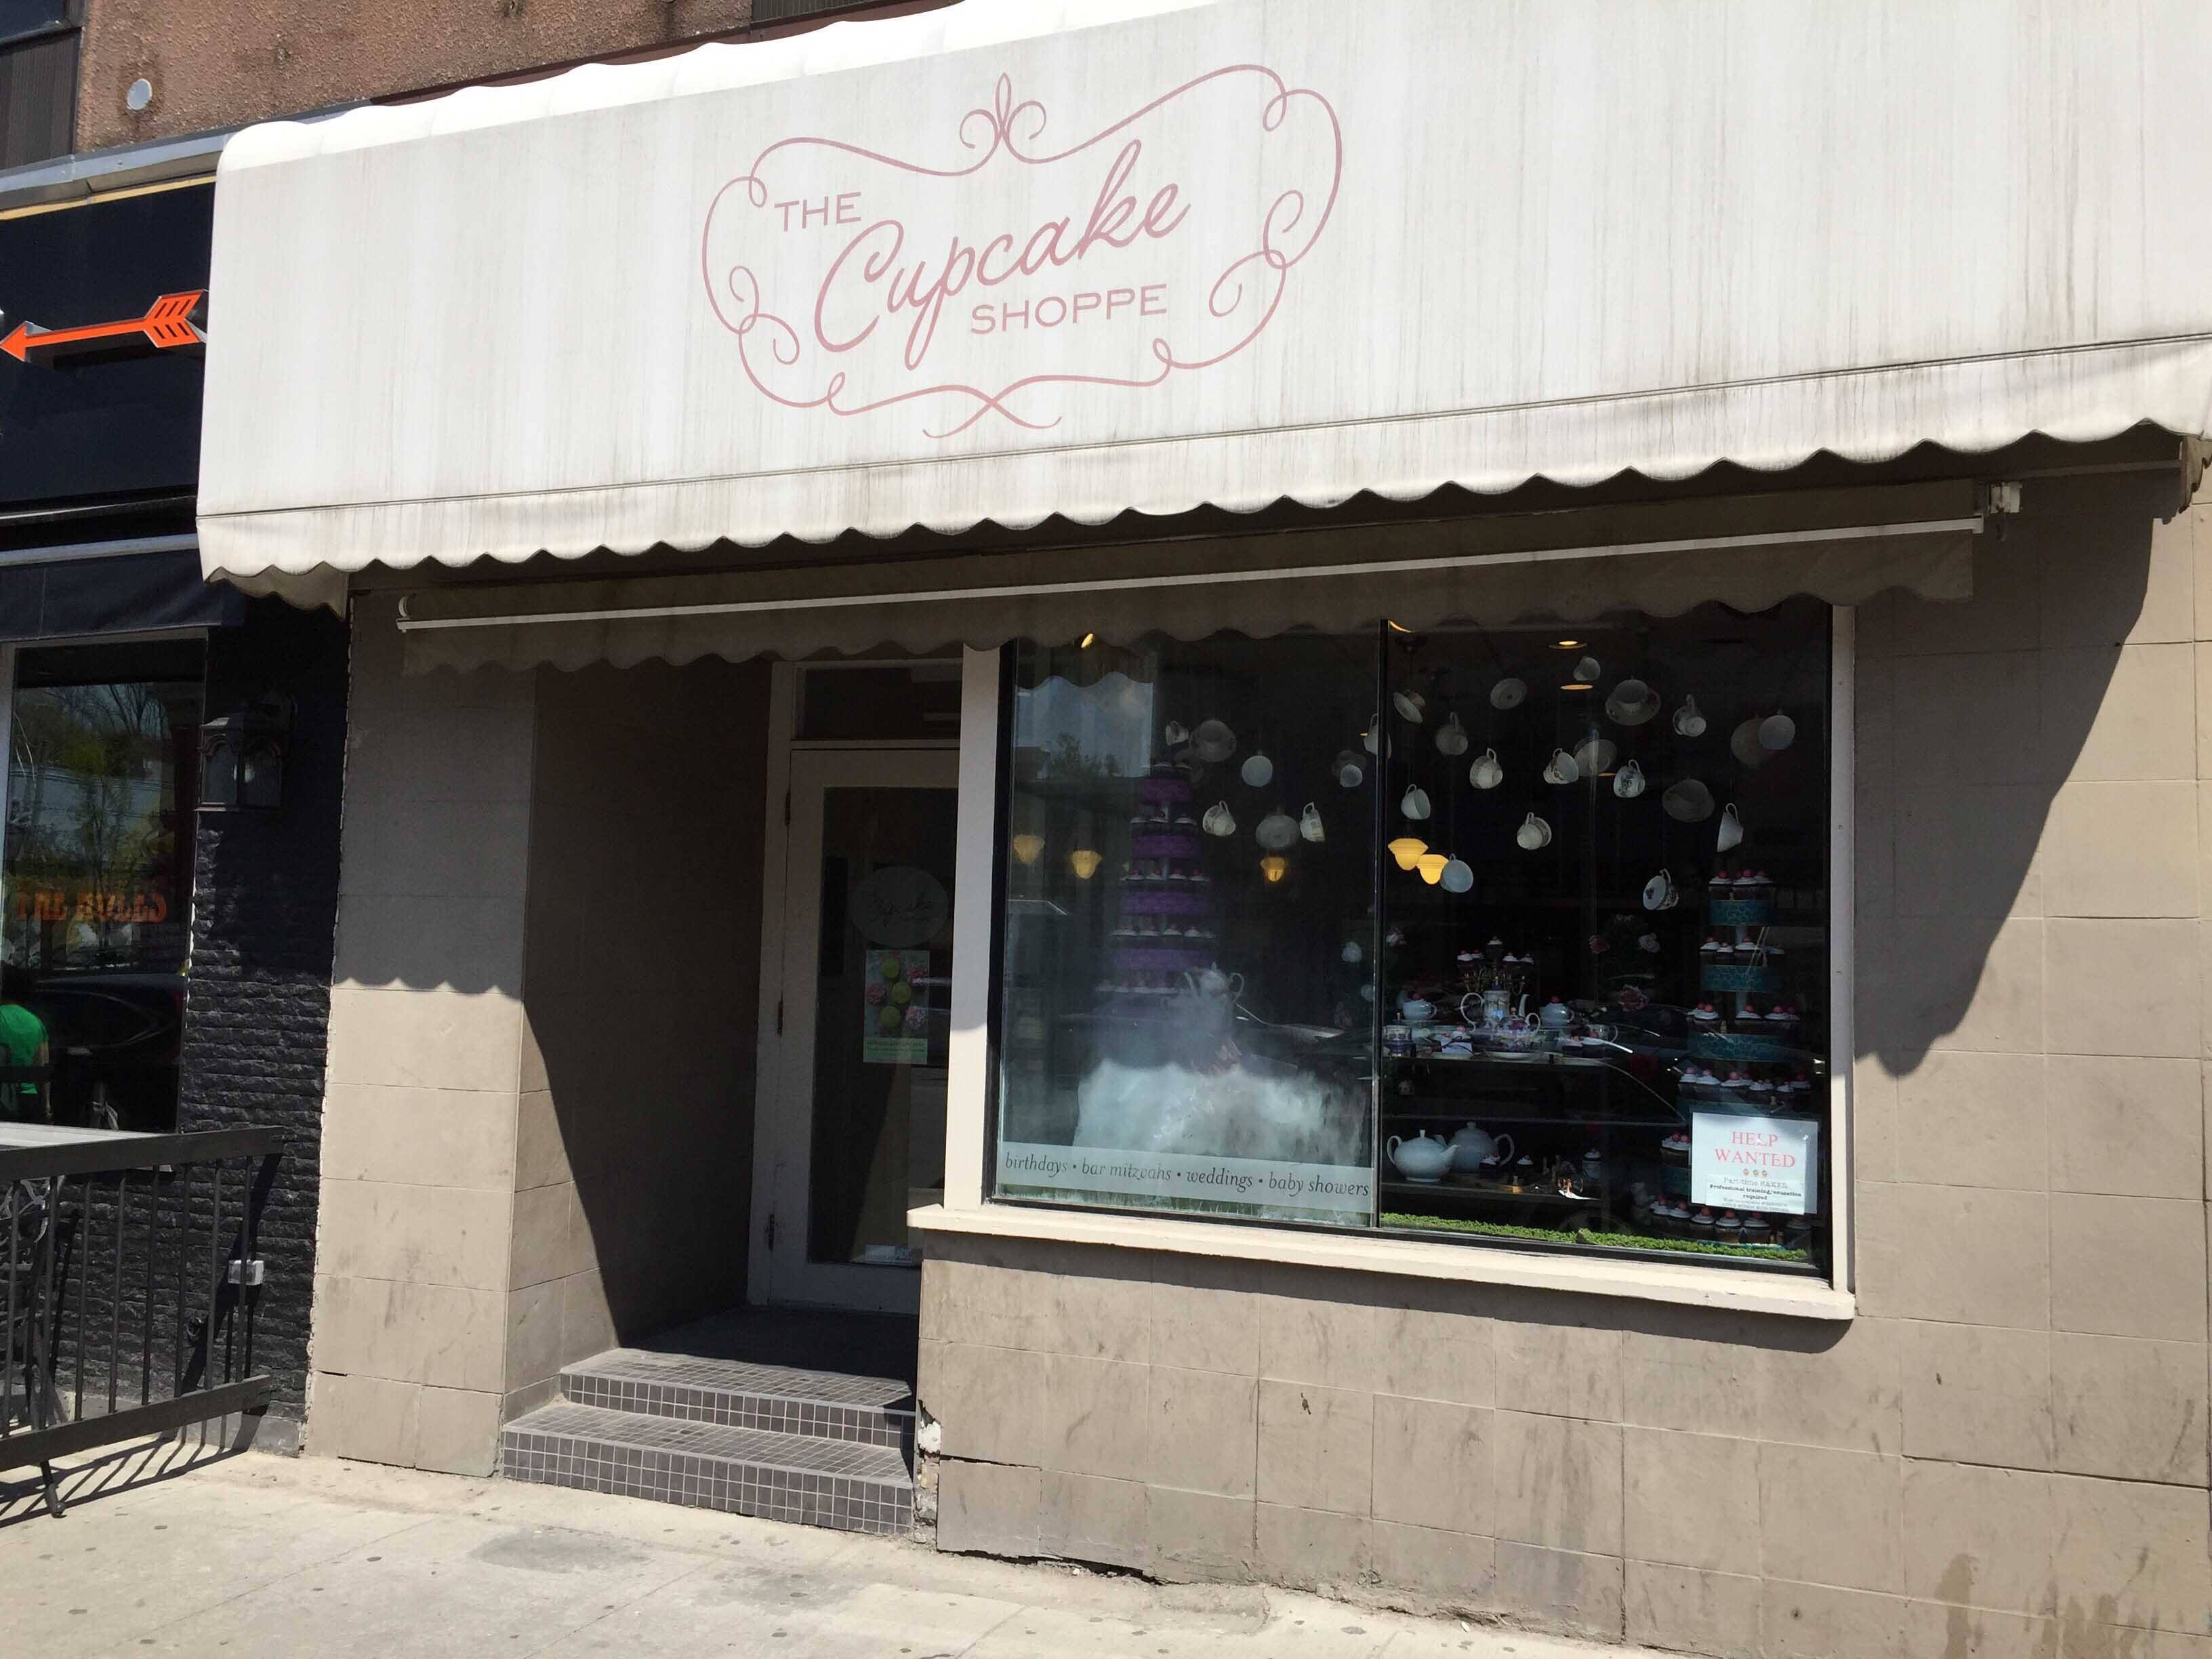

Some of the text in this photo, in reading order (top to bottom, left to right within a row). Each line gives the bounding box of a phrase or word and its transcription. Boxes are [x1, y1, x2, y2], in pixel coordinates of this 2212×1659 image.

[774, 192, 862, 232] THE
[814, 139, 1191, 370] Cupcake
[970, 283, 1168, 335] SHOPPE
[1715, 1149, 1795, 1168] WANTED
[1731, 1131, 1778, 1147] HELP
[1006, 1152, 1370, 1196] birthdays bar mitzvahs weddings baby showers
